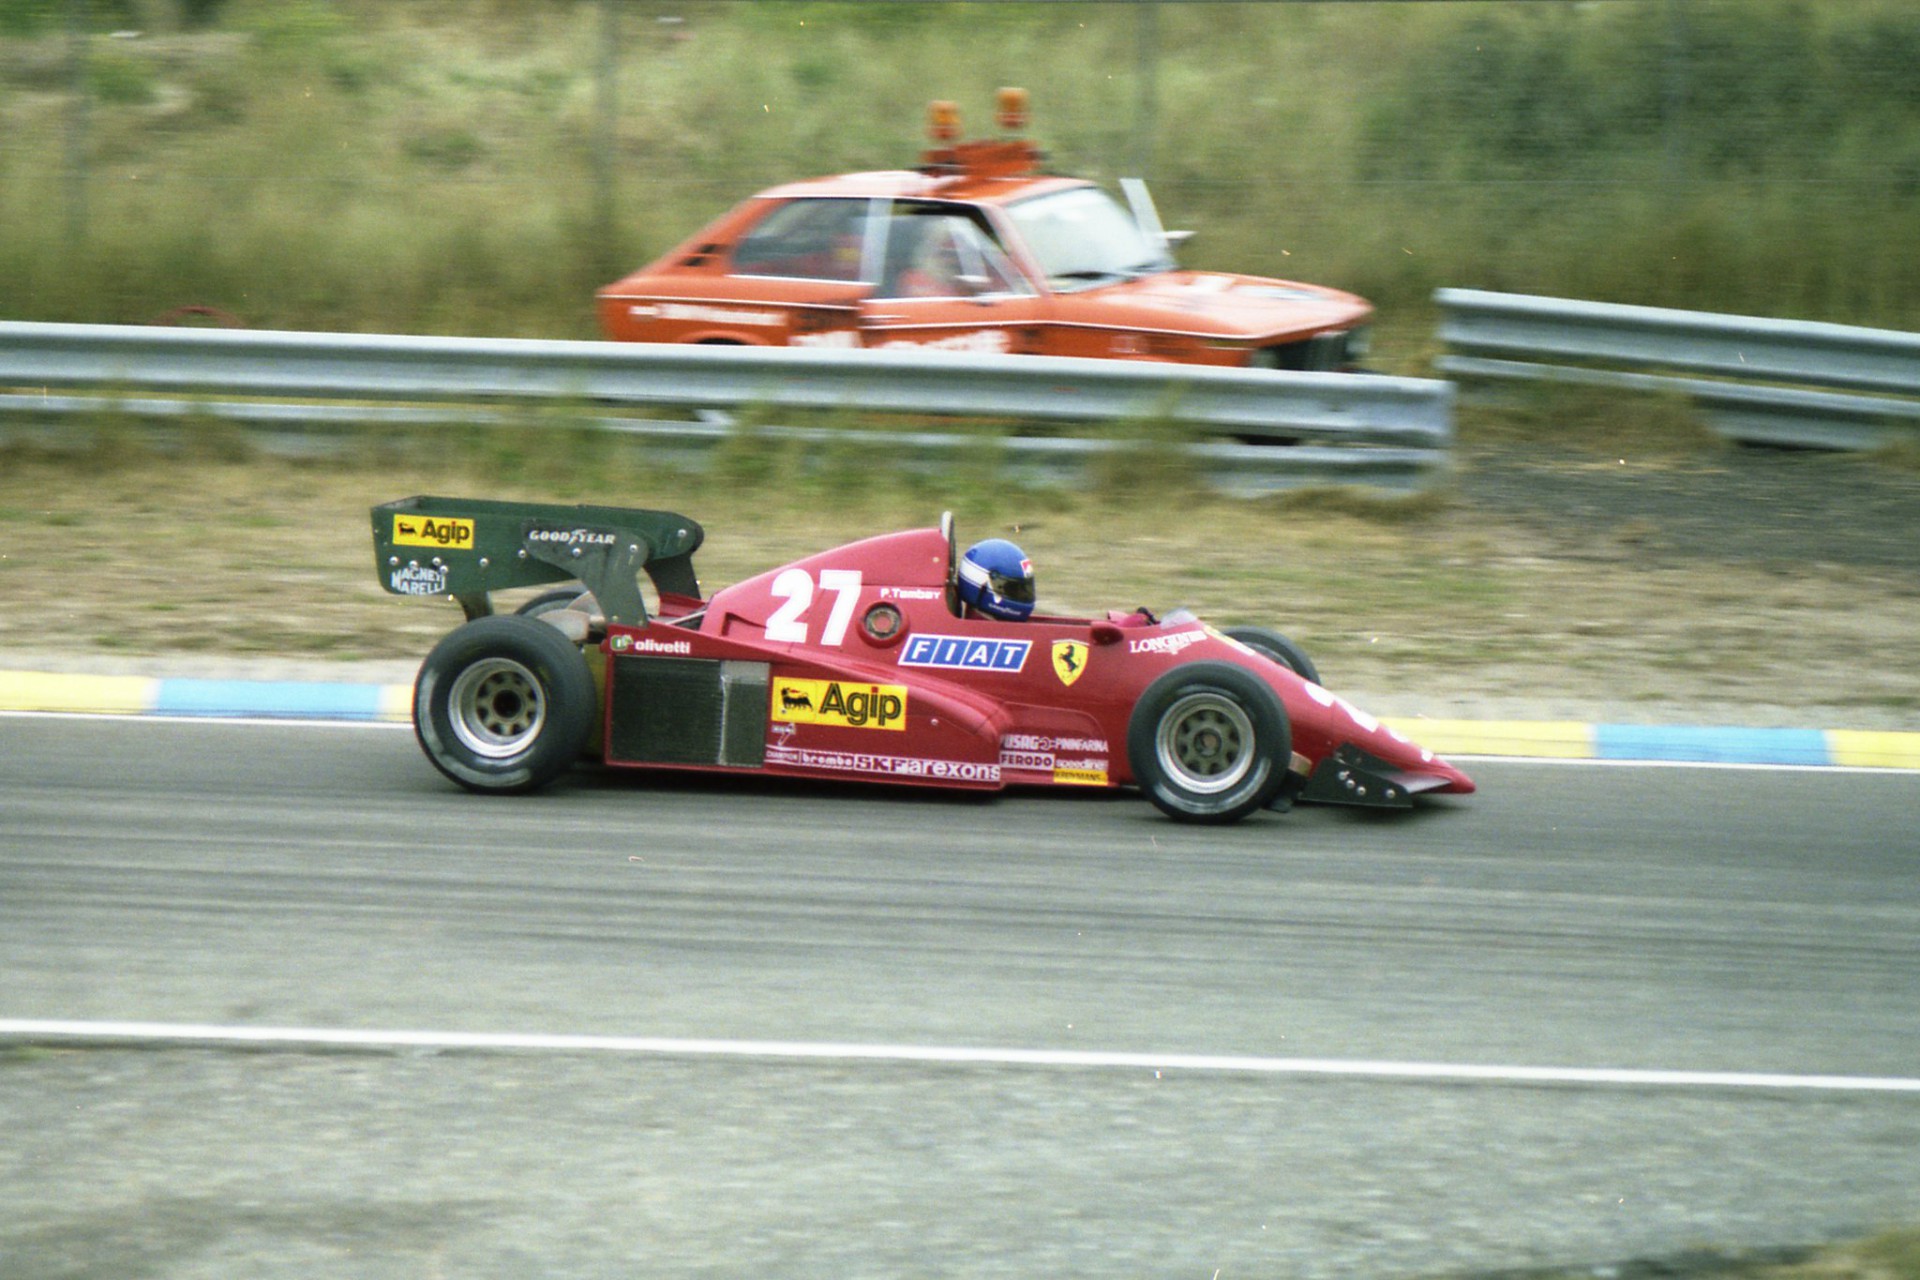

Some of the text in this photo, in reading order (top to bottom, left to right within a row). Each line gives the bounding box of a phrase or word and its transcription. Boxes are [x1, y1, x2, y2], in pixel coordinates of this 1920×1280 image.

[421, 519, 470, 544] Agip
[529, 528, 617, 545] GOODYEAR
[391, 576, 446, 595] MARELLI
[764, 568, 862, 646] 27
[634, 639, 691, 654] olivetti
[908, 638, 1025, 667] FIAT
[818, 682, 902, 726] Agip
[907, 759, 1000, 780] arexons
[1000, 753, 1053, 768] FERODO
